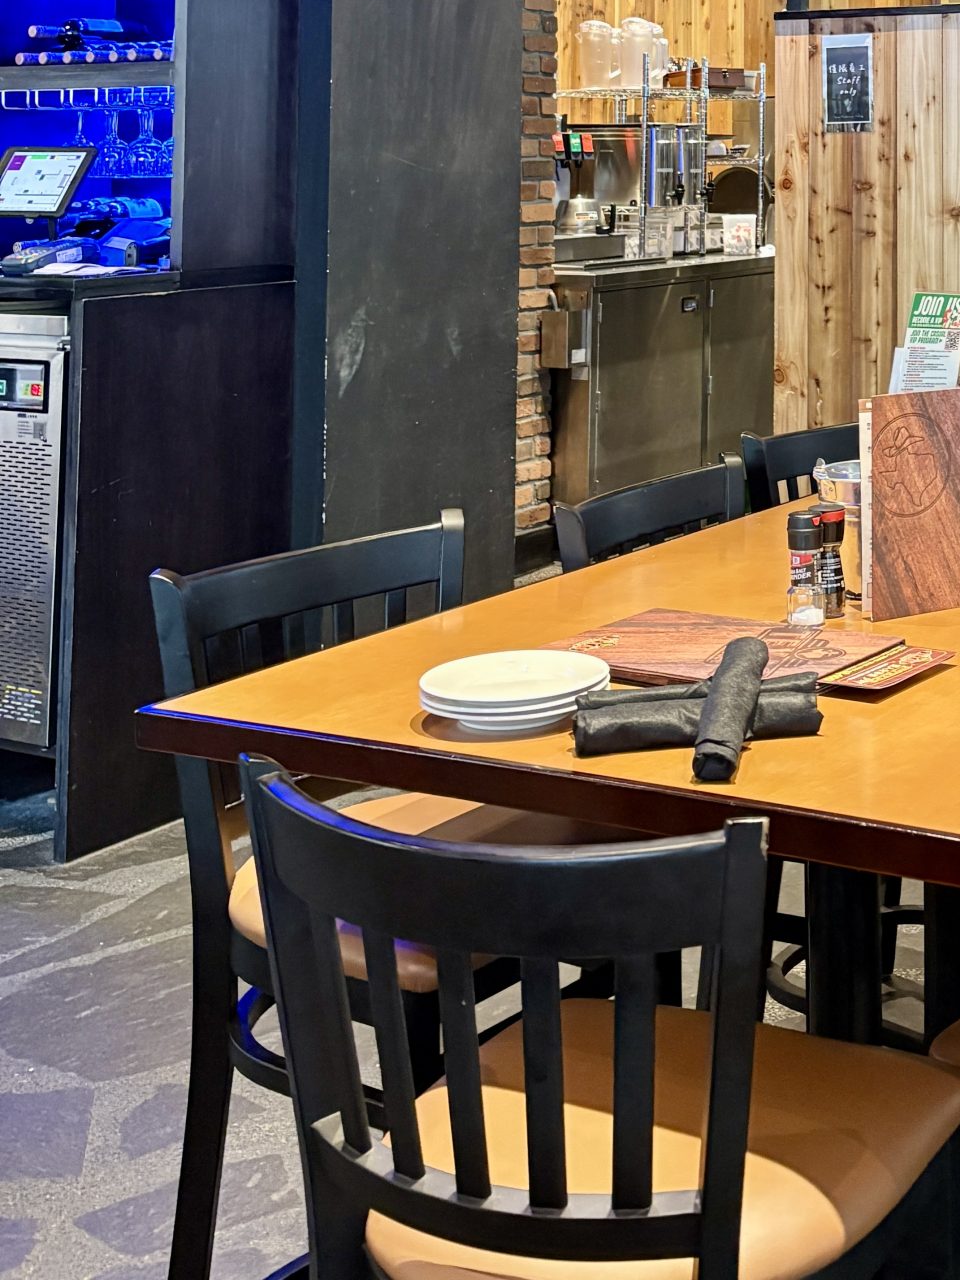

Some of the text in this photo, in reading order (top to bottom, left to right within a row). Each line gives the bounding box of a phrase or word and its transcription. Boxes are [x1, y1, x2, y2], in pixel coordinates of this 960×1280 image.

[837, 76, 861, 85] Staff
[840, 87, 857, 96] only
[913, 296, 944, 316] JOIN
